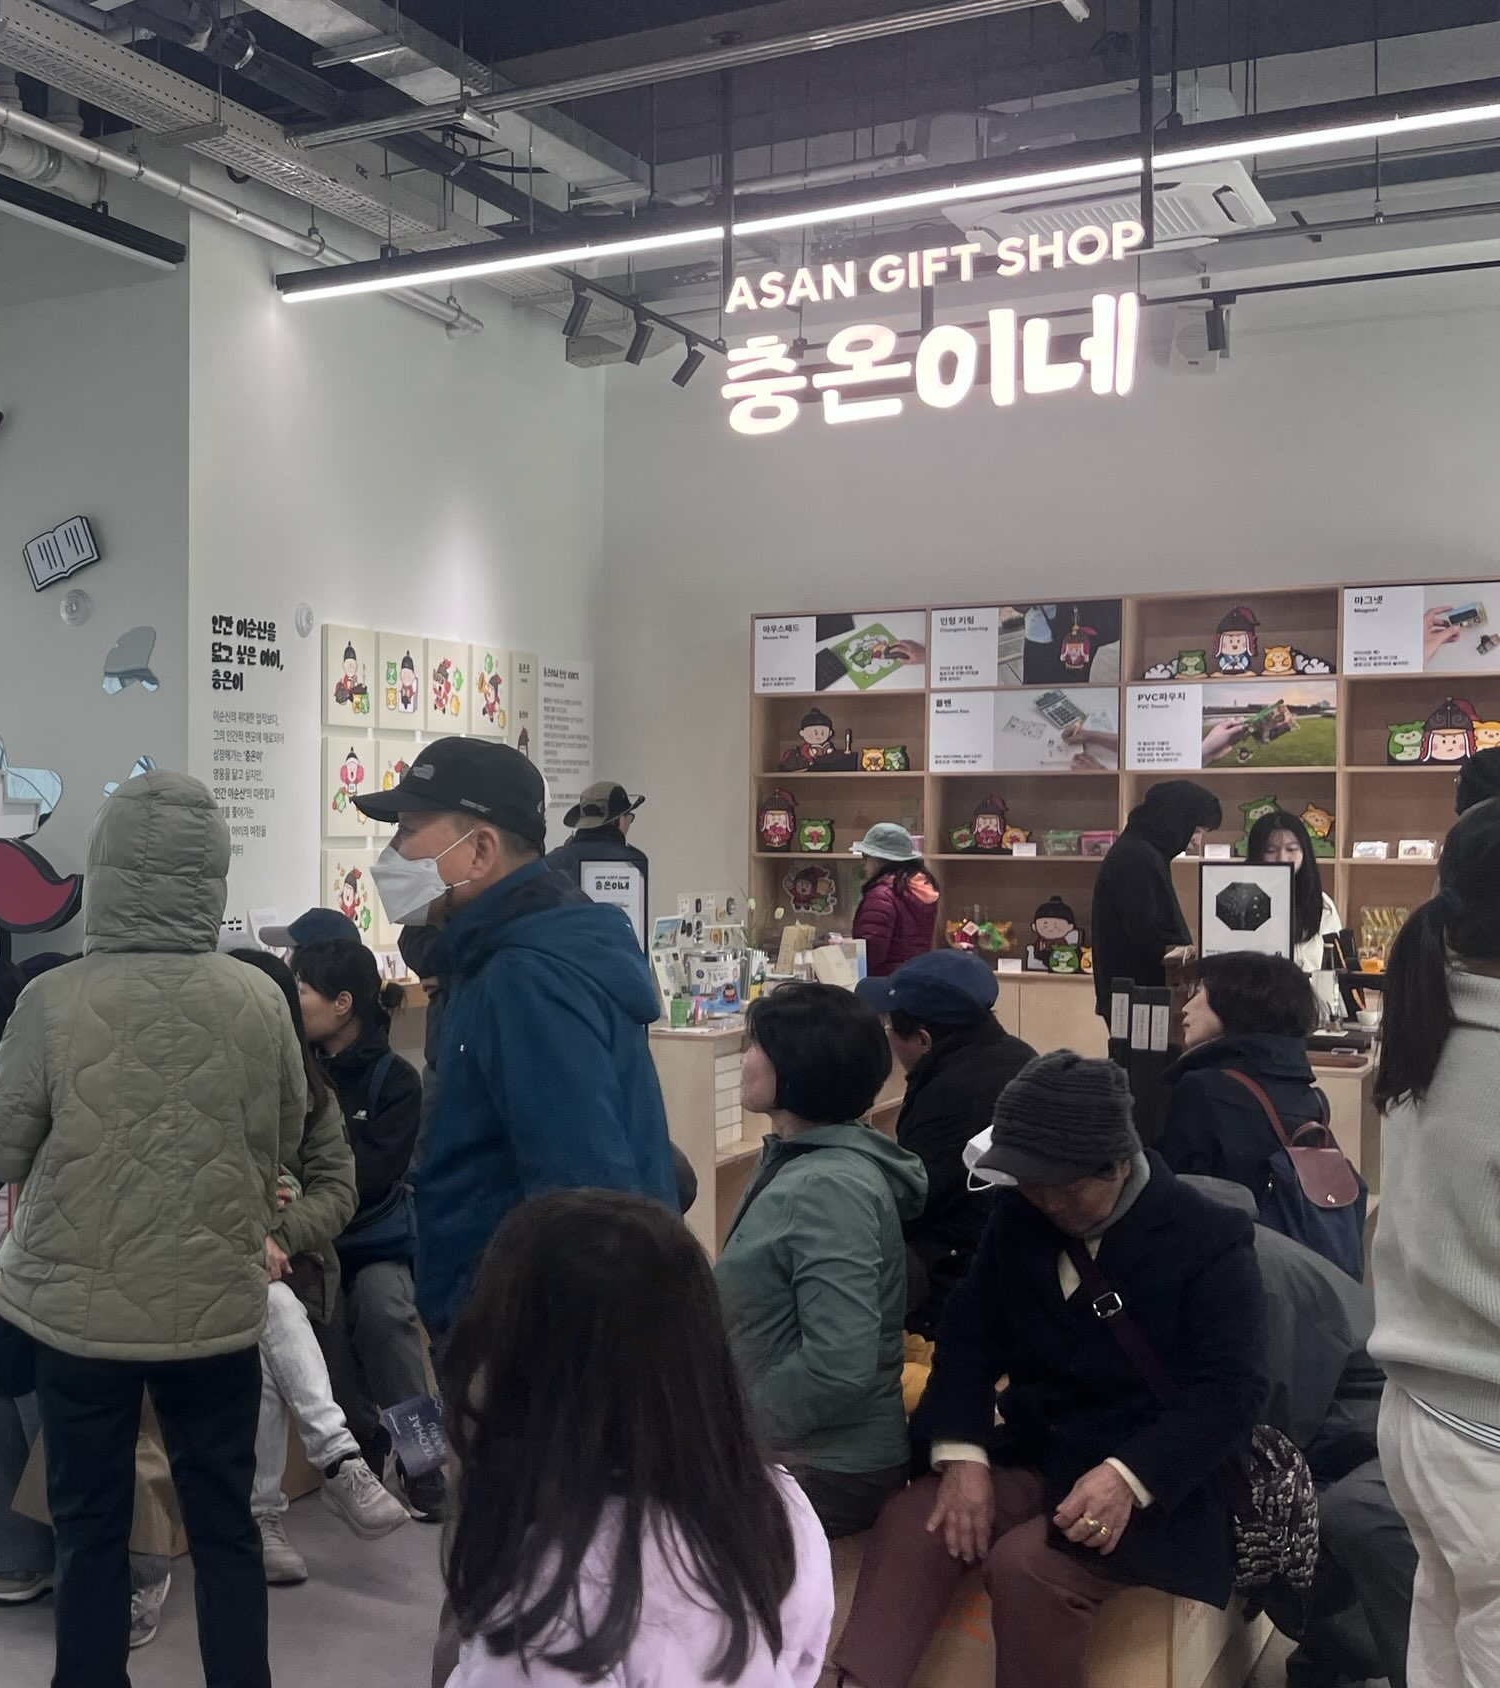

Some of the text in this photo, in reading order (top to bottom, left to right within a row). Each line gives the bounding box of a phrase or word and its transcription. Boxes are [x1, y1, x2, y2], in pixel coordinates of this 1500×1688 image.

[725, 220, 1145, 313] ASAN GIFT SHOP
[721, 291, 1140, 435] 충온이네
[1354, 595, 1383, 605] 마그넷
[211, 614, 277, 642] 인간 이순신을
[762, 624, 800, 633] 마우스패드
[211, 641, 233, 663] 닮고
[236, 644, 257, 666] 싶은
[211, 668, 244, 691] 충온이
[1137, 691, 1186, 701] PVC파우치
